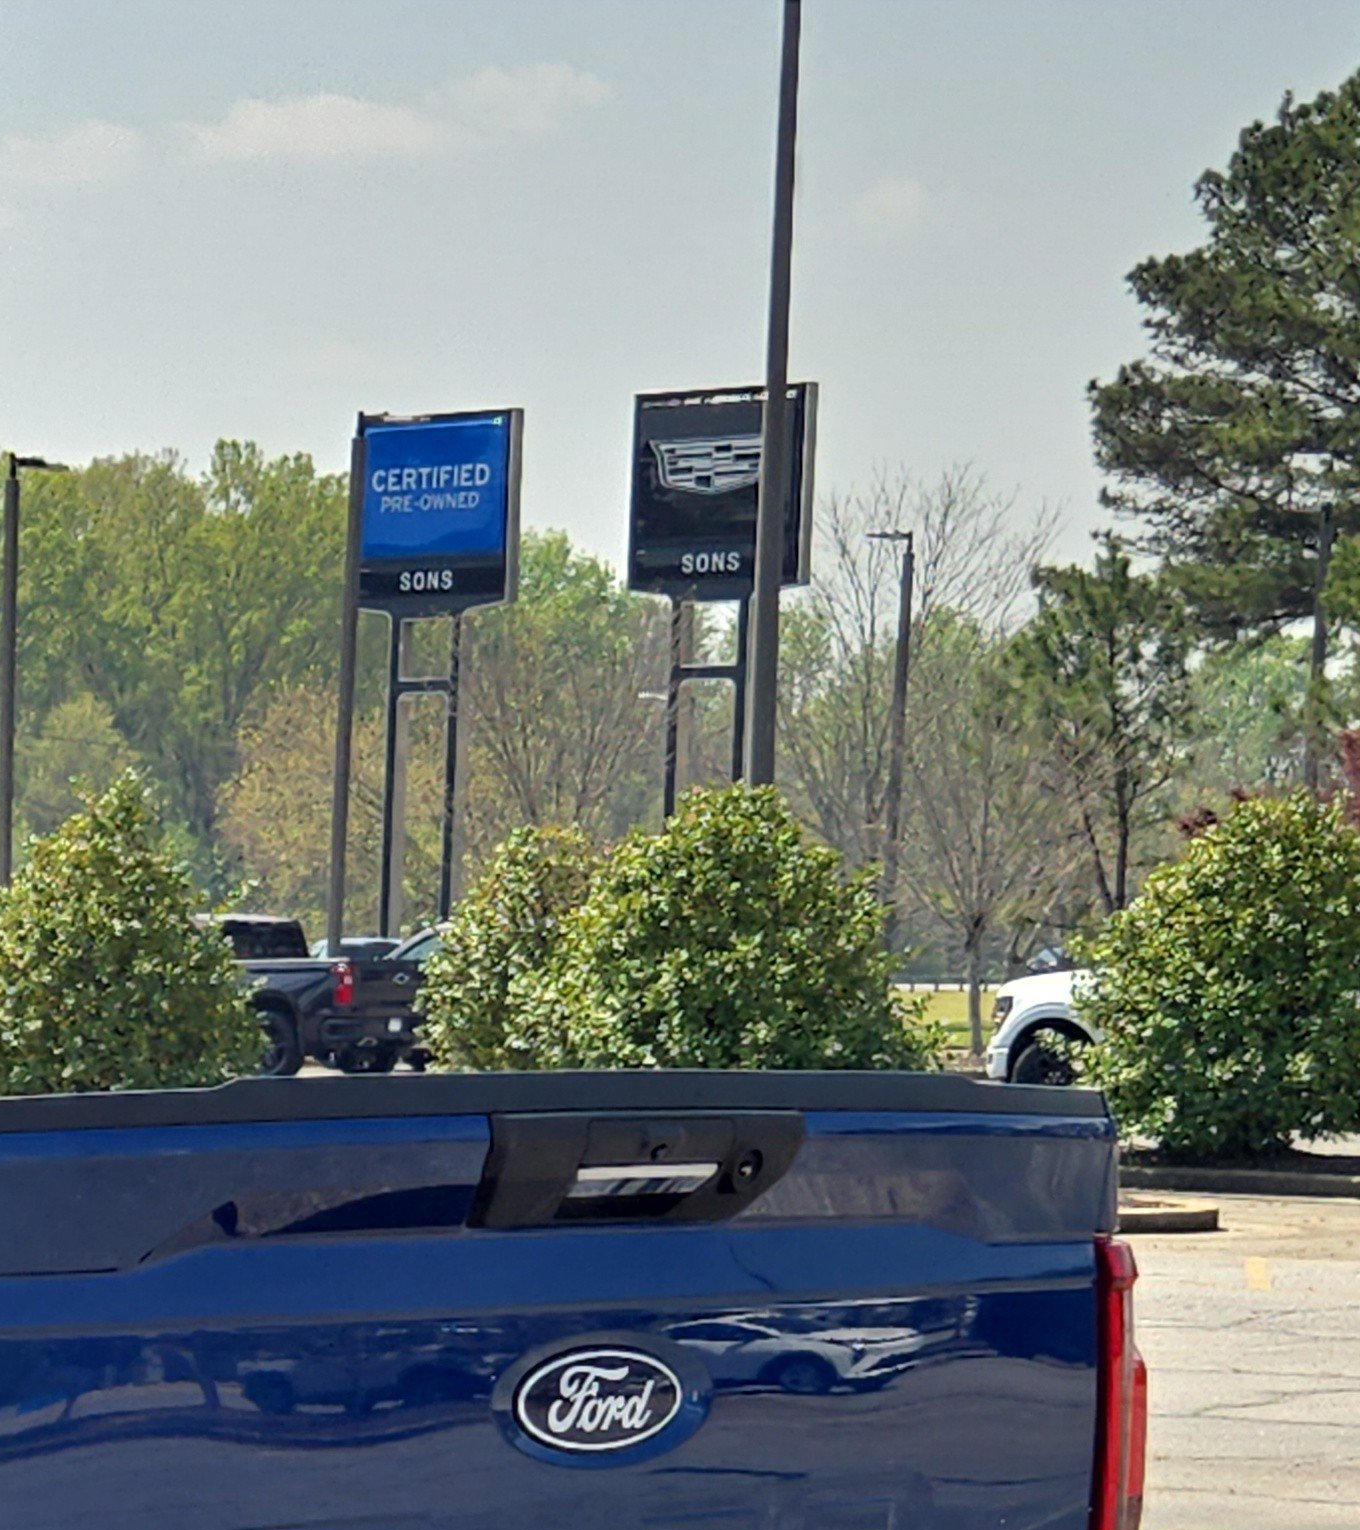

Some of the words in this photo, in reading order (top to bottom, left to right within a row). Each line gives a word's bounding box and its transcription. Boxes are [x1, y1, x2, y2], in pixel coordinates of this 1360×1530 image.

[371, 463, 490, 492] CERTIFIED
[380, 491, 480, 513] PRE-OWNED
[681, 551, 740, 574] SONS
[399, 569, 453, 591] SONS
[547, 1364, 655, 1433] Ford
